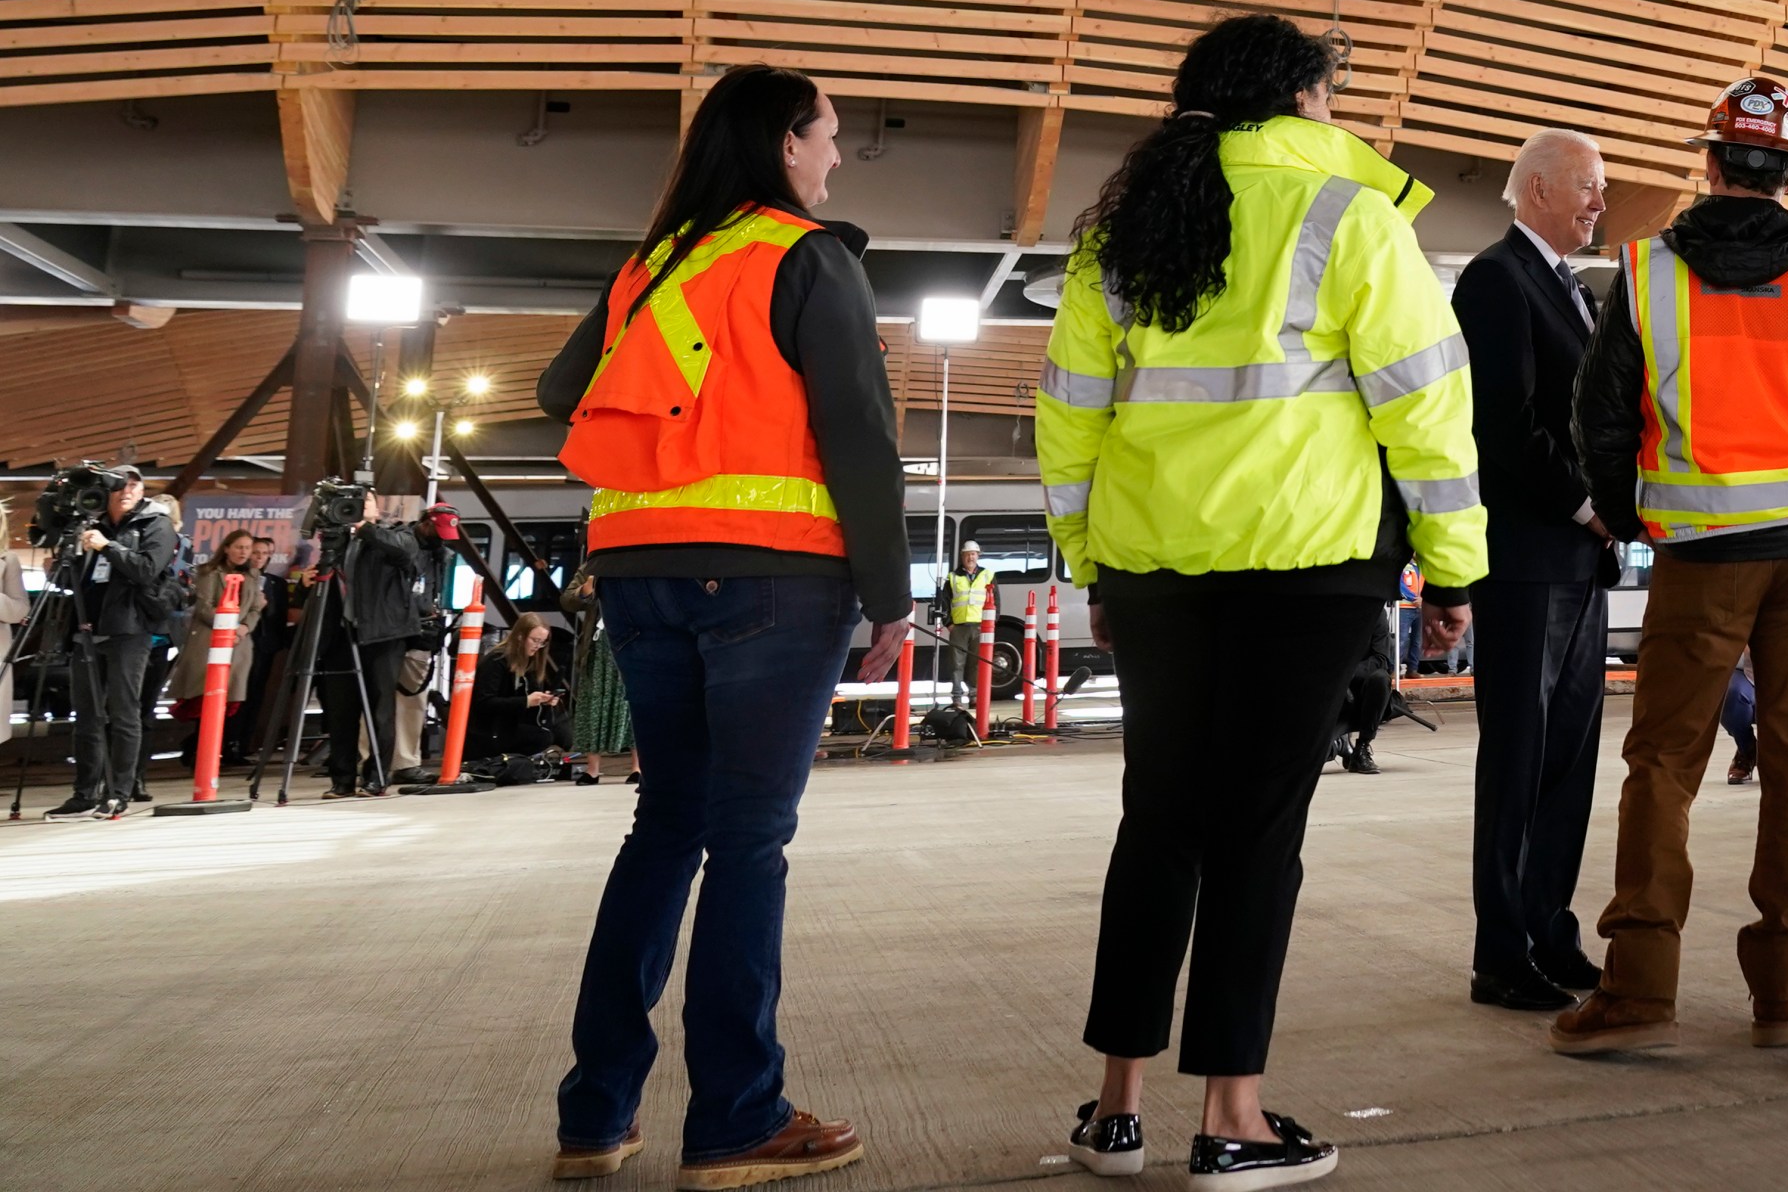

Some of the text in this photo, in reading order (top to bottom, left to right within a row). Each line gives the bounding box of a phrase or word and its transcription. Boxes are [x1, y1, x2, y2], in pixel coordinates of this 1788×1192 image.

[1747, 99, 1766, 109] PDX
[1746, 118, 1777, 128] EMERGENCY
[195, 507, 294, 519] YOU HAVE THE
